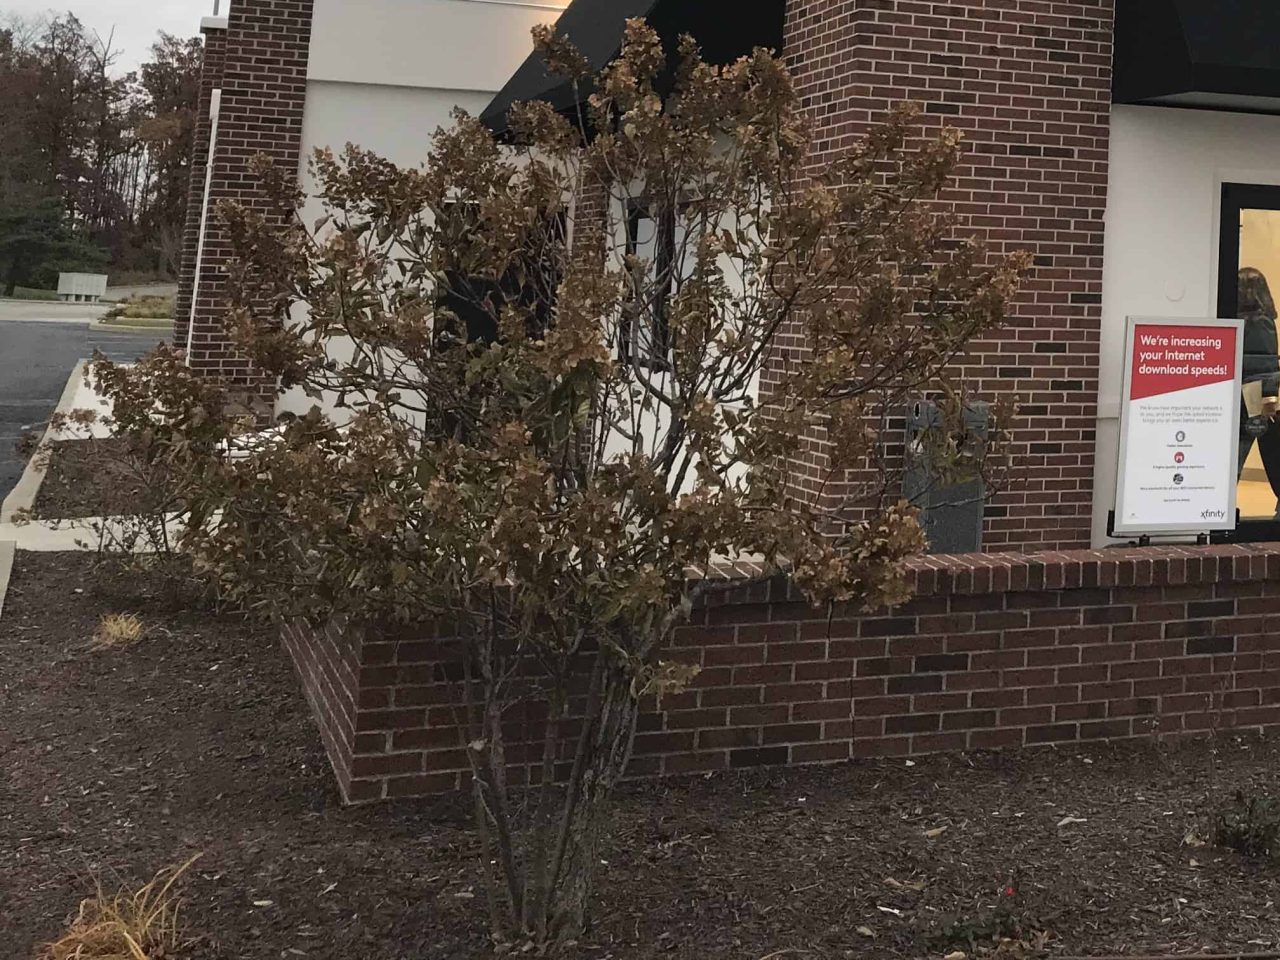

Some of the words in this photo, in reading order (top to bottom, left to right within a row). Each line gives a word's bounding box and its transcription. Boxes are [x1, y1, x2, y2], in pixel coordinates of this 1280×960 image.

[1140, 335, 1168, 346] We're
[1171, 335, 1222, 350] increasing
[1140, 350, 1163, 363] your
[1165, 349, 1205, 361] Internet
[1138, 363, 1189, 375] download
[1190, 365, 1228, 377] speeds!
[1200, 509, 1226, 519] xfinity
